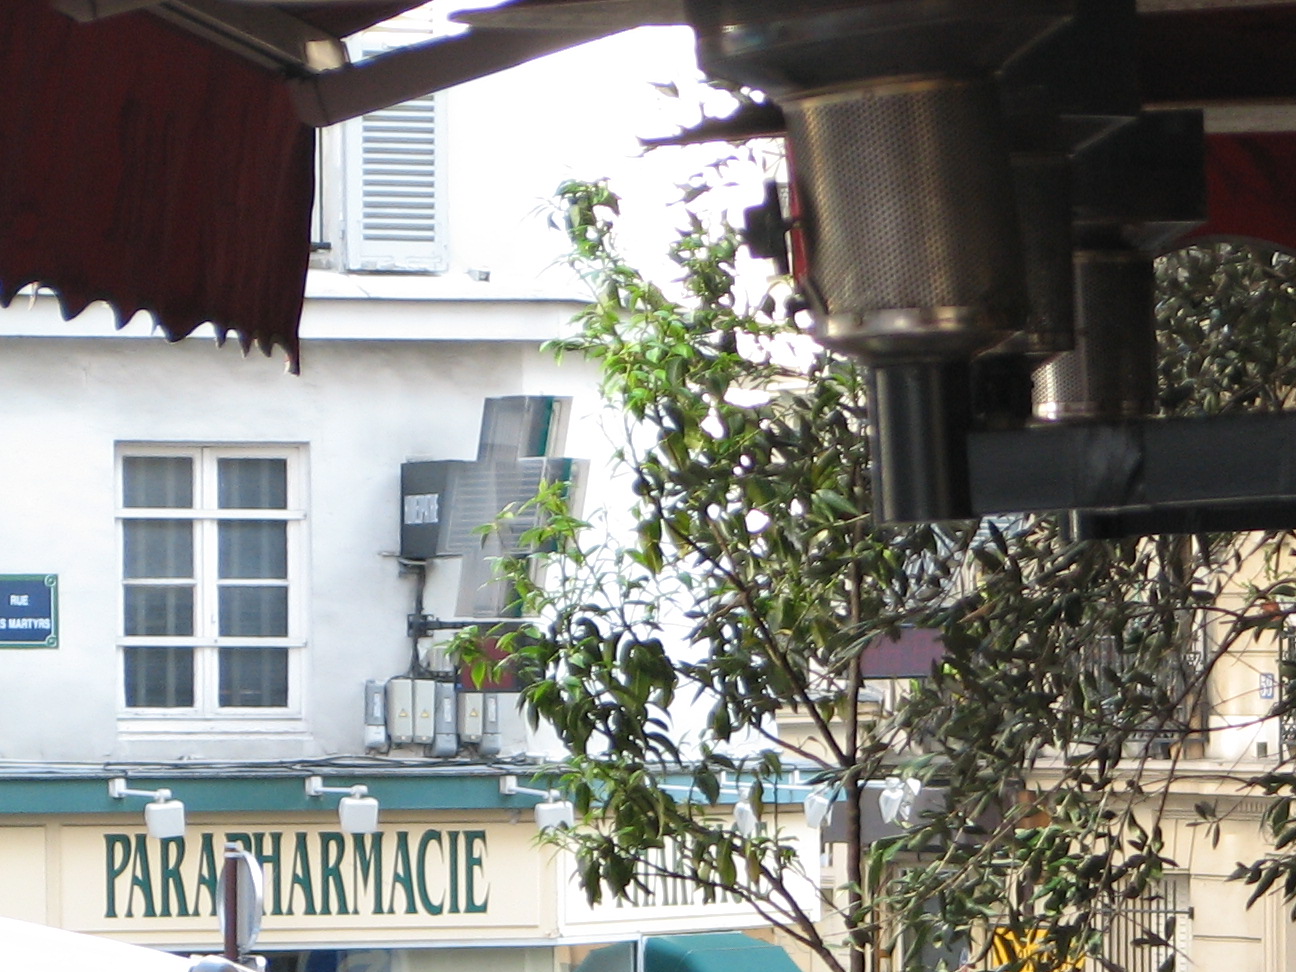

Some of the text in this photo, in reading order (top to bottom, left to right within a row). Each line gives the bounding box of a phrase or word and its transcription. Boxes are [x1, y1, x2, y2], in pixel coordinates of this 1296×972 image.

[10, 594, 29, 606] RUE
[8, 618, 51, 630] MARTYRS
[103, 828, 491, 919] PARAHARMACIE
